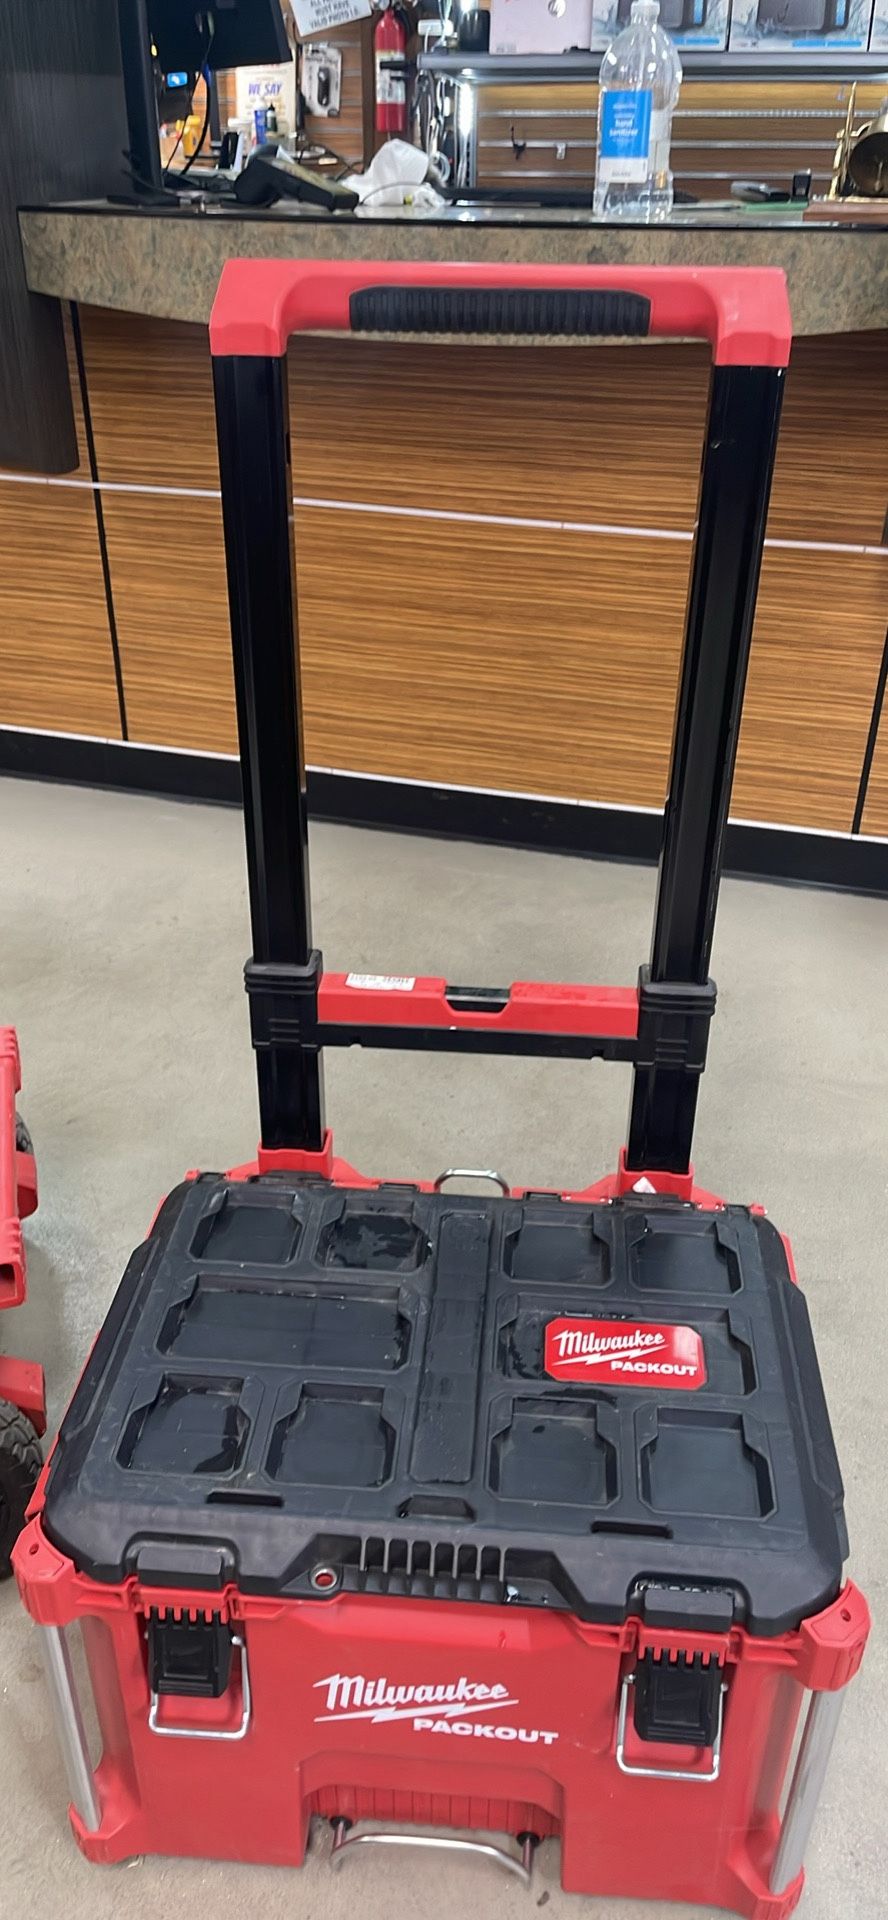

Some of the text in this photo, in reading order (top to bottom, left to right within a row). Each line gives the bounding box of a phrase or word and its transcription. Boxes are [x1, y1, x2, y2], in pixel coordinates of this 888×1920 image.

[263, 82, 282, 96] SAY
[552, 1329, 665, 1357] Milwaukee
[610, 1361, 697, 1376] PACKOUT
[312, 1673, 509, 1711] Milwaukee
[413, 1718, 559, 1745] PACKOUT
